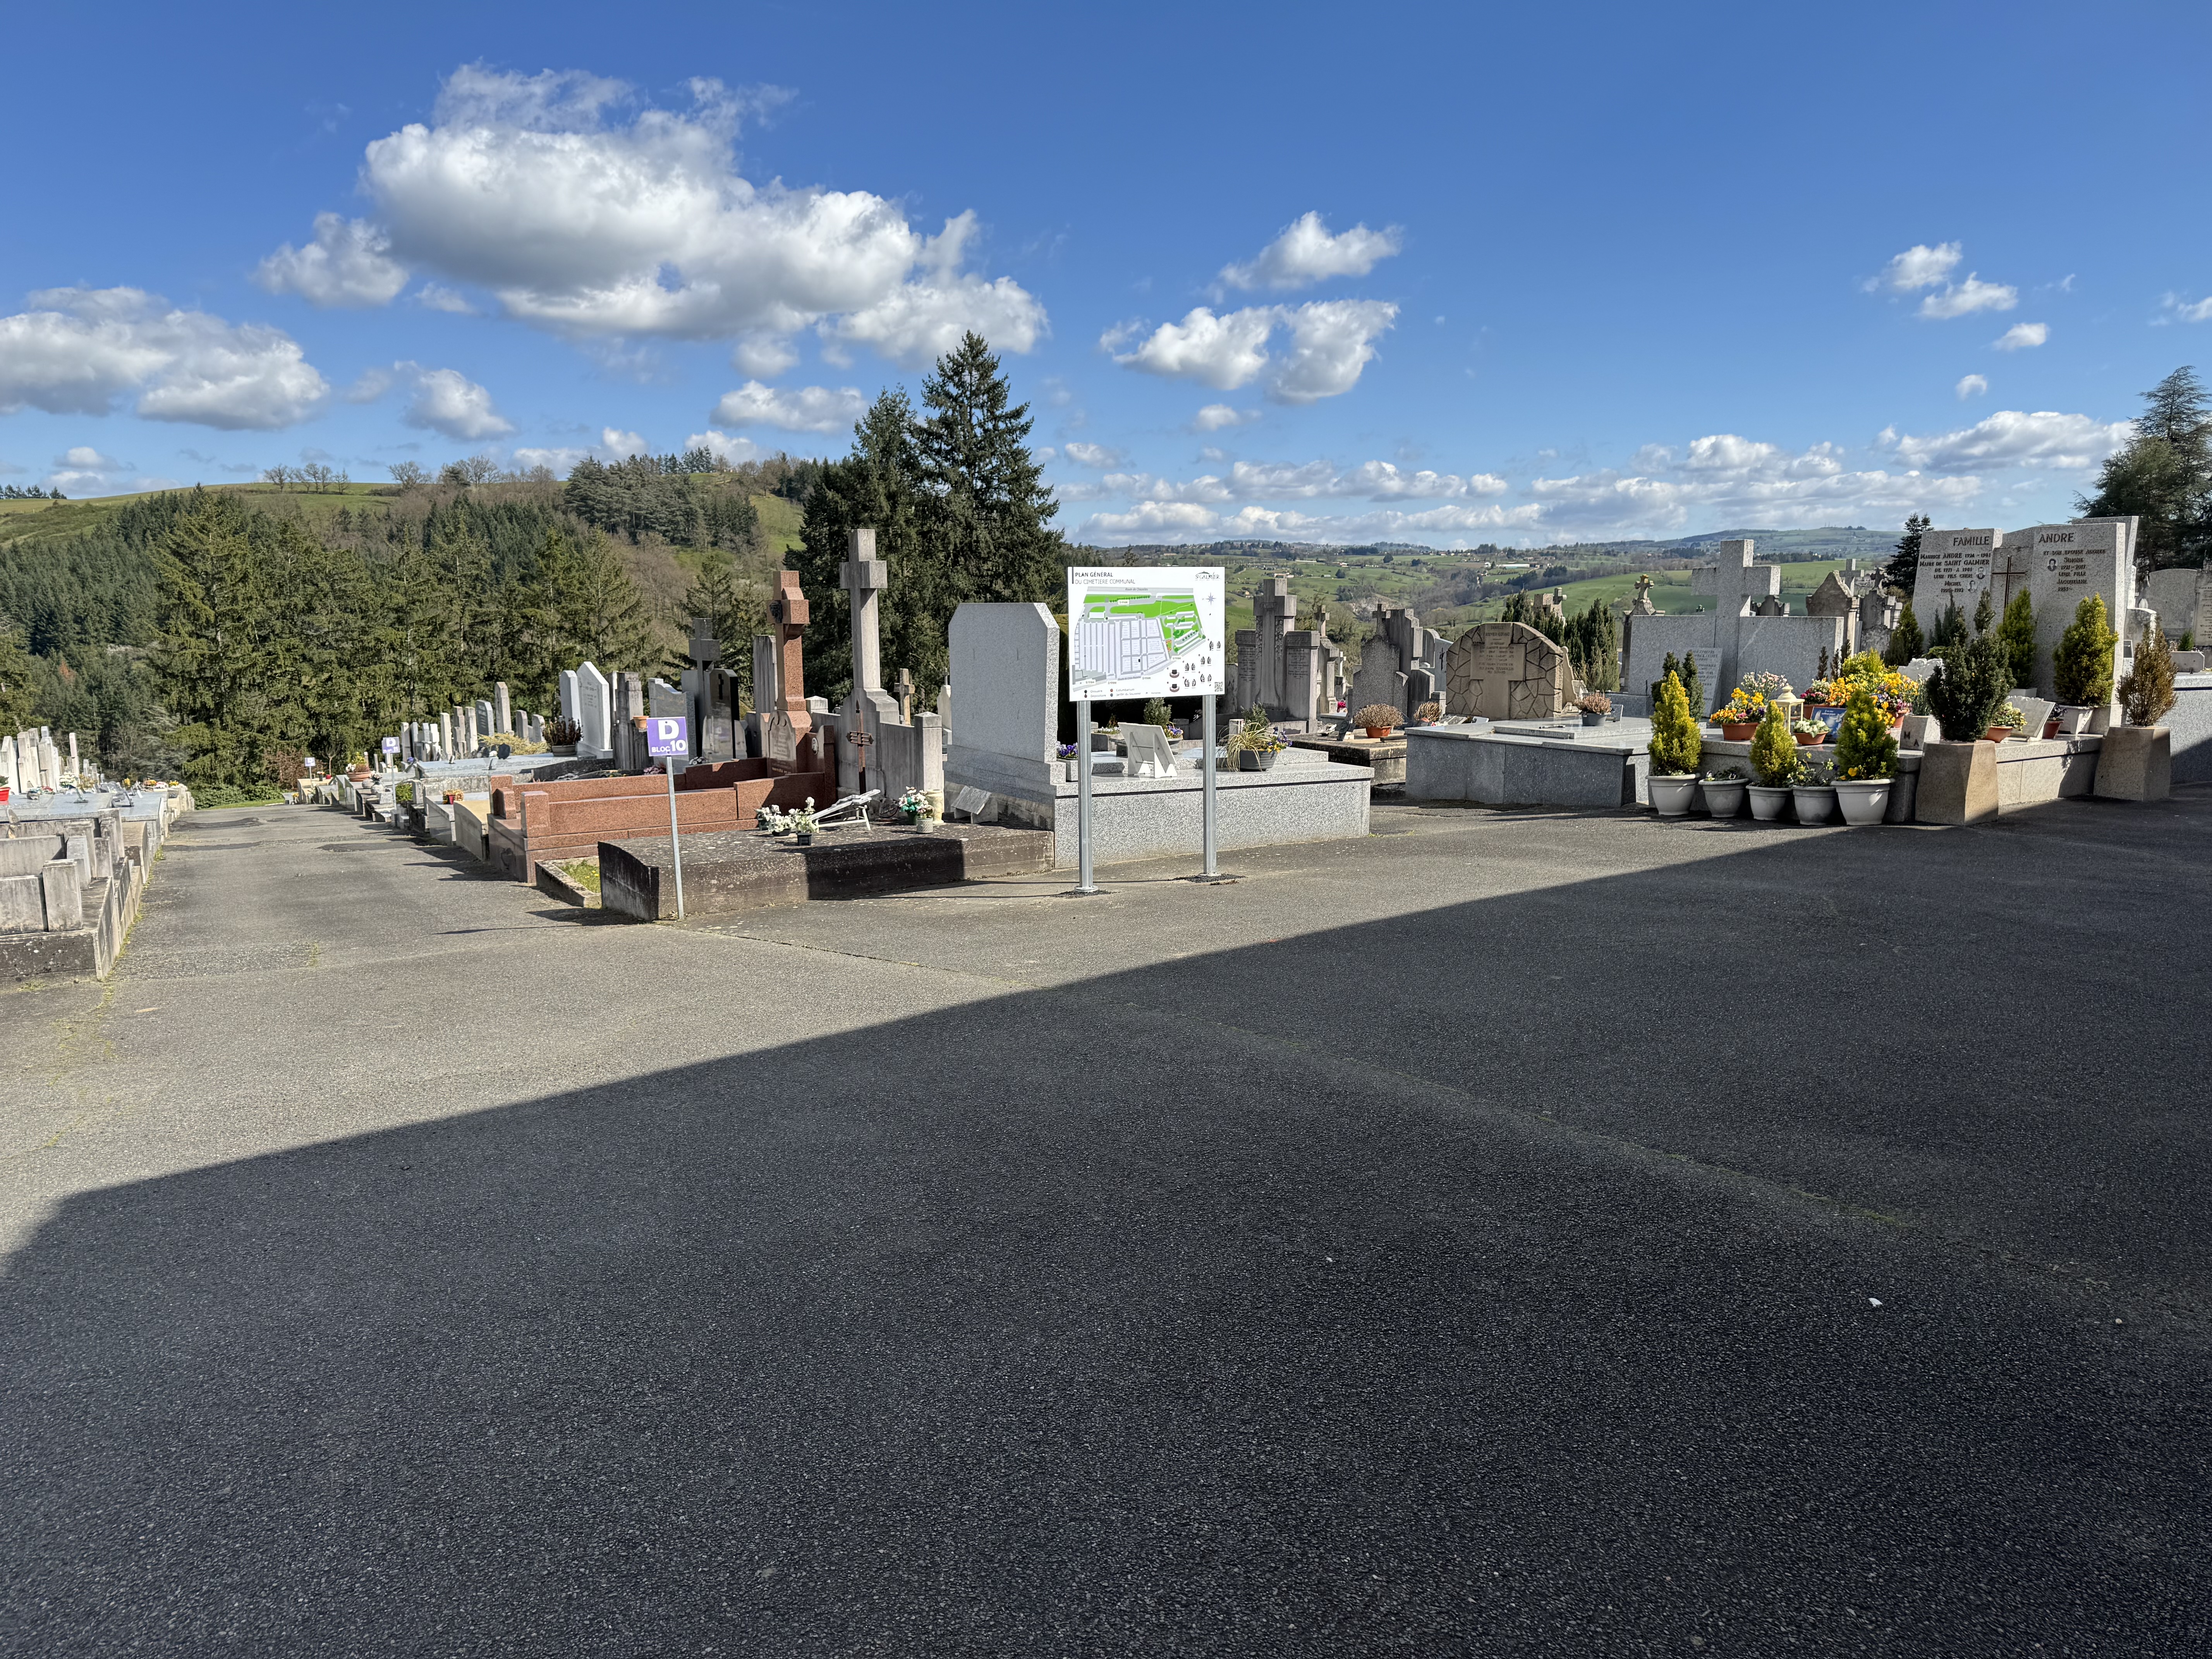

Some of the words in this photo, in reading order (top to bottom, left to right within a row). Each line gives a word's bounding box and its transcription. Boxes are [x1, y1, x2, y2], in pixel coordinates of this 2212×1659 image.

[1953, 536, 1989, 546] FAMILLE
[2039, 533, 2074, 543] ANDRE
[658, 720, 679, 740] D
[1904, 731, 1910, 740] M
[386, 738, 396, 747] D
[670, 740, 687, 751] 10
[1914, 739, 1919, 747] A
